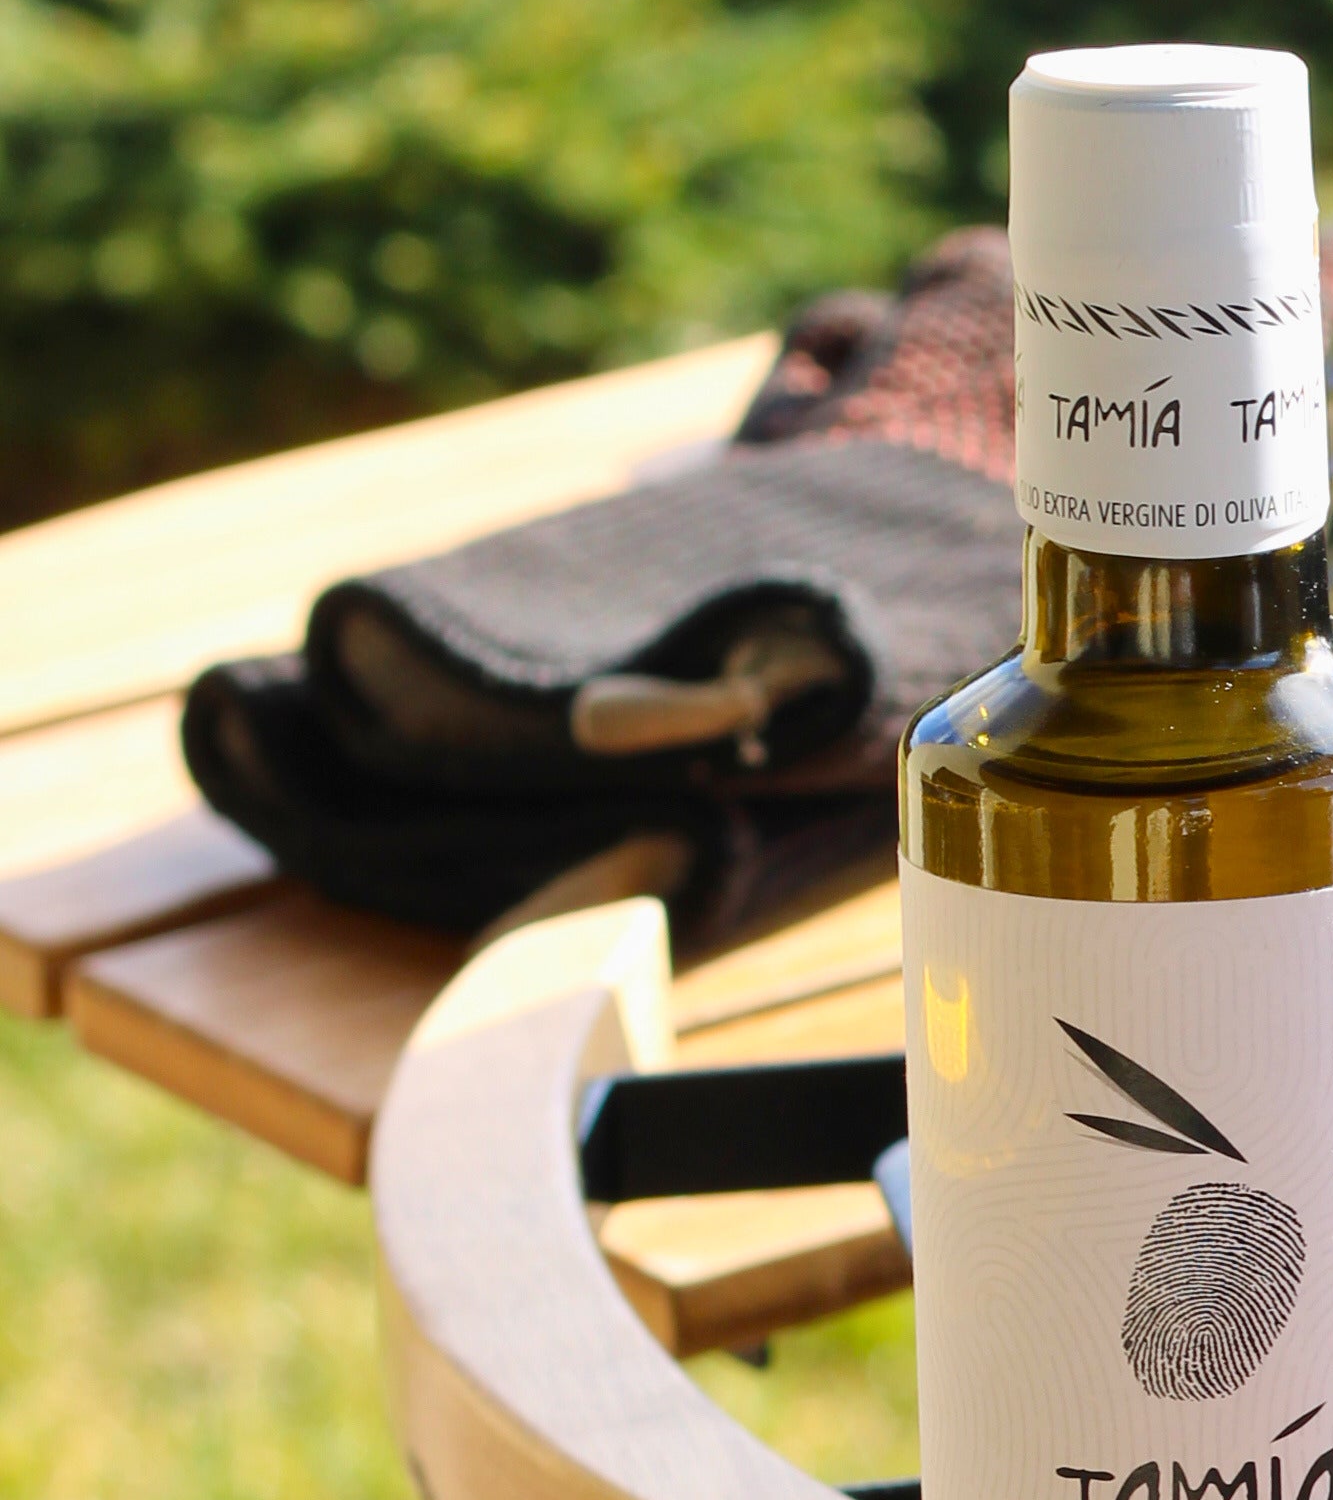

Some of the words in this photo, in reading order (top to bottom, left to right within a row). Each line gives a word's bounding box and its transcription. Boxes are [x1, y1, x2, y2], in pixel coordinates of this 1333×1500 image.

[1048, 374, 1182, 449] TAMÍA
[1044, 490, 1092, 523] EXTRA
[1097, 500, 1187, 528] VERGINE
[1195, 502, 1216, 527] DI
[1224, 494, 1278, 525] OLIVA
